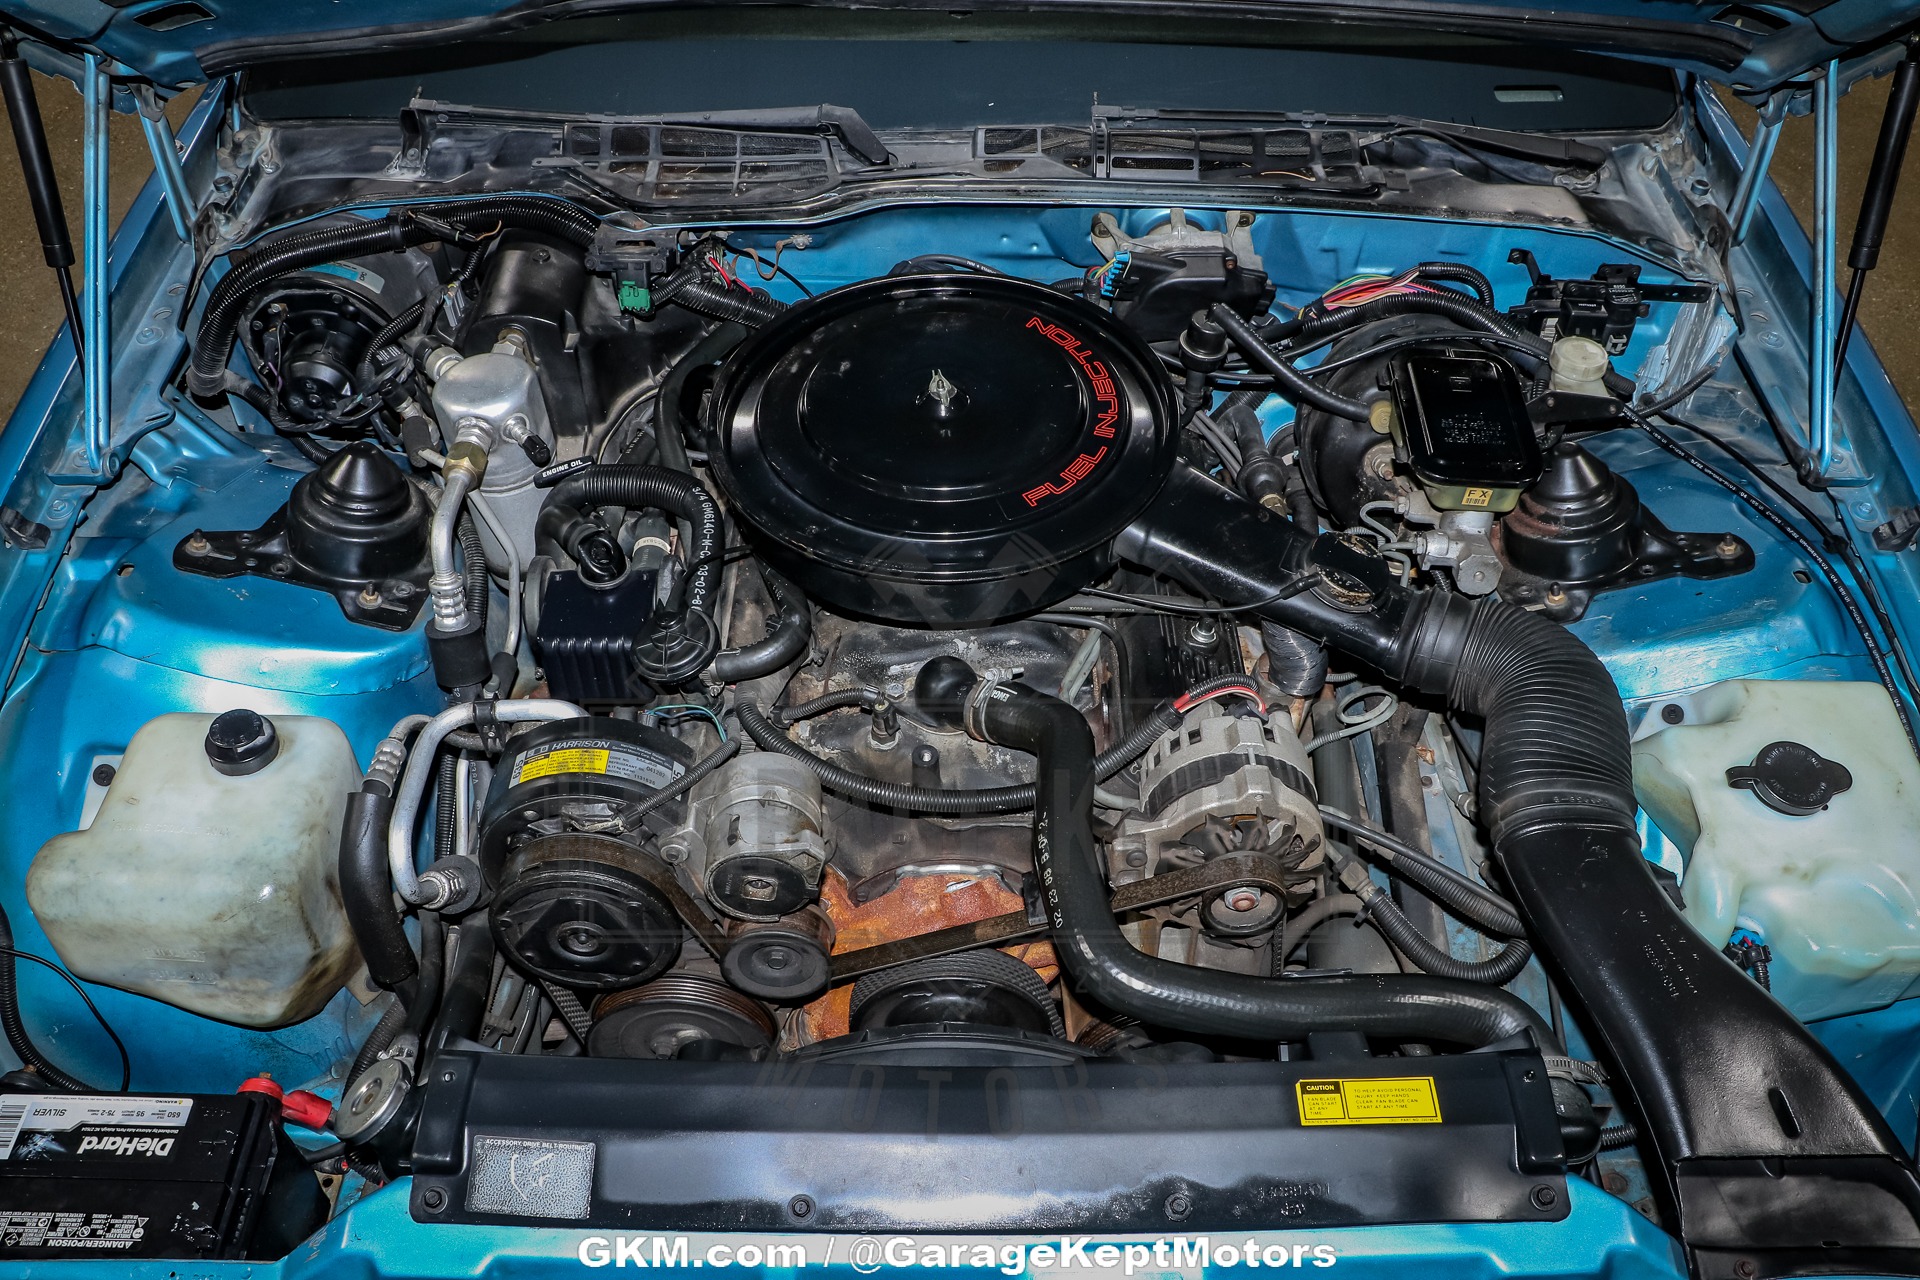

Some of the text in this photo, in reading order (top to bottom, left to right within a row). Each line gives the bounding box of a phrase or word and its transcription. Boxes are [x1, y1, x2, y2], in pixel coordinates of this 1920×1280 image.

[1022, 316, 1119, 507] FUEL INJECTION
[542, 459, 583, 478] ENGINE OIL
[692, 486, 707, 501] 3/4
[551, 740, 611, 751] HARRISON
[1048, 888, 1059, 907] 23
[32, 1108, 67, 1117] SILVER
[100, 1109, 116, 1117] 75-2
[167, 1111, 181, 1119] 650
[77, 1135, 175, 1157] DieHard
[485, 1138, 521, 1146] ACCESSORY
[558, 1143, 587, 1151] ROUTING
[47, 1239, 125, 1249] DANGER/POISON
